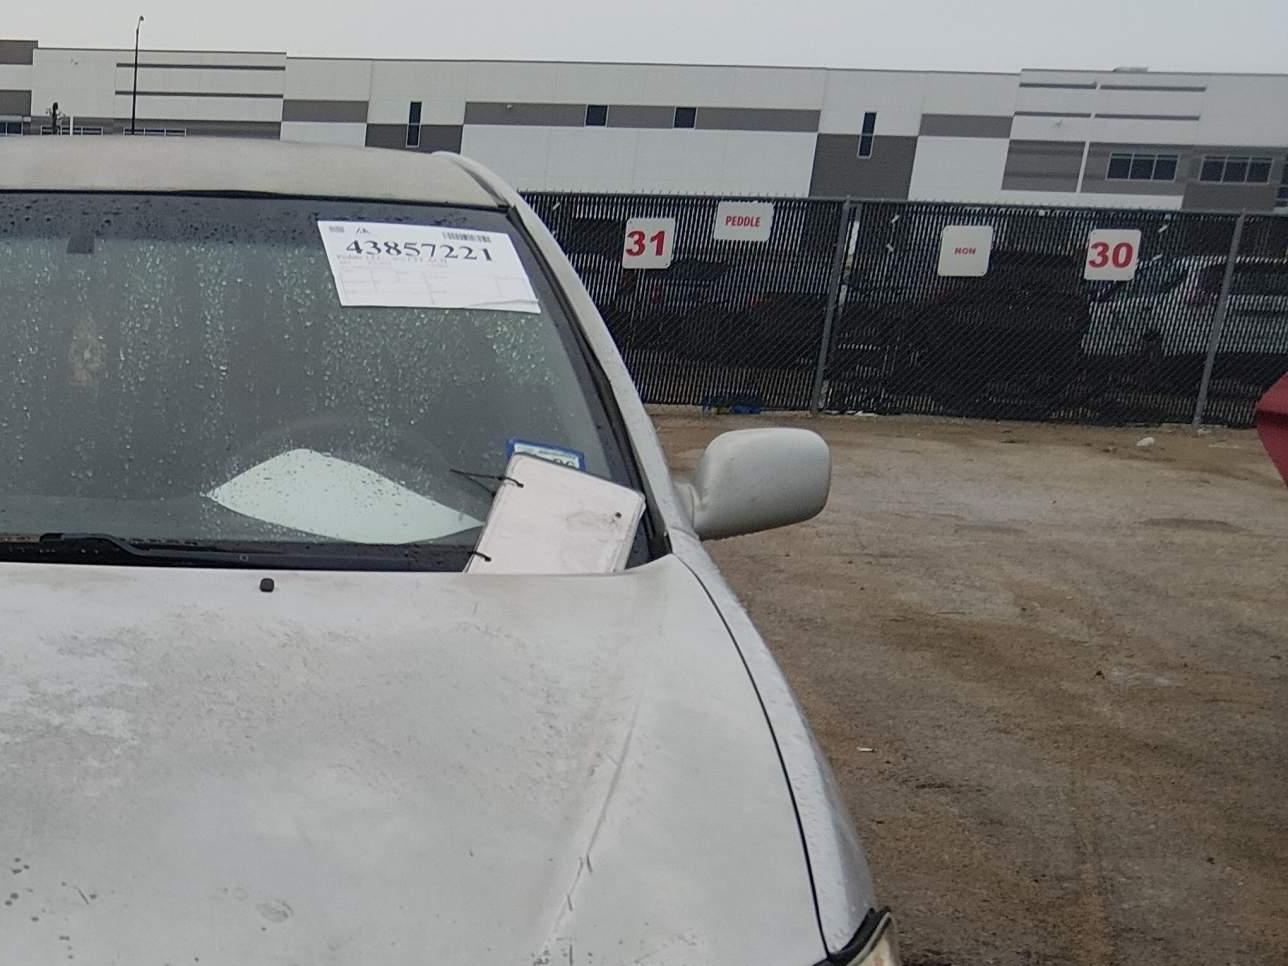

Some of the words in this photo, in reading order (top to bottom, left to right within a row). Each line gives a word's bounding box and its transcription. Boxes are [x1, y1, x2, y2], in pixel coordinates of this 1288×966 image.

[725, 215, 761, 228] PEDDLE
[346, 240, 493, 262] 43857221
[625, 230, 666, 257] 31
[1088, 242, 1134, 269] 30
